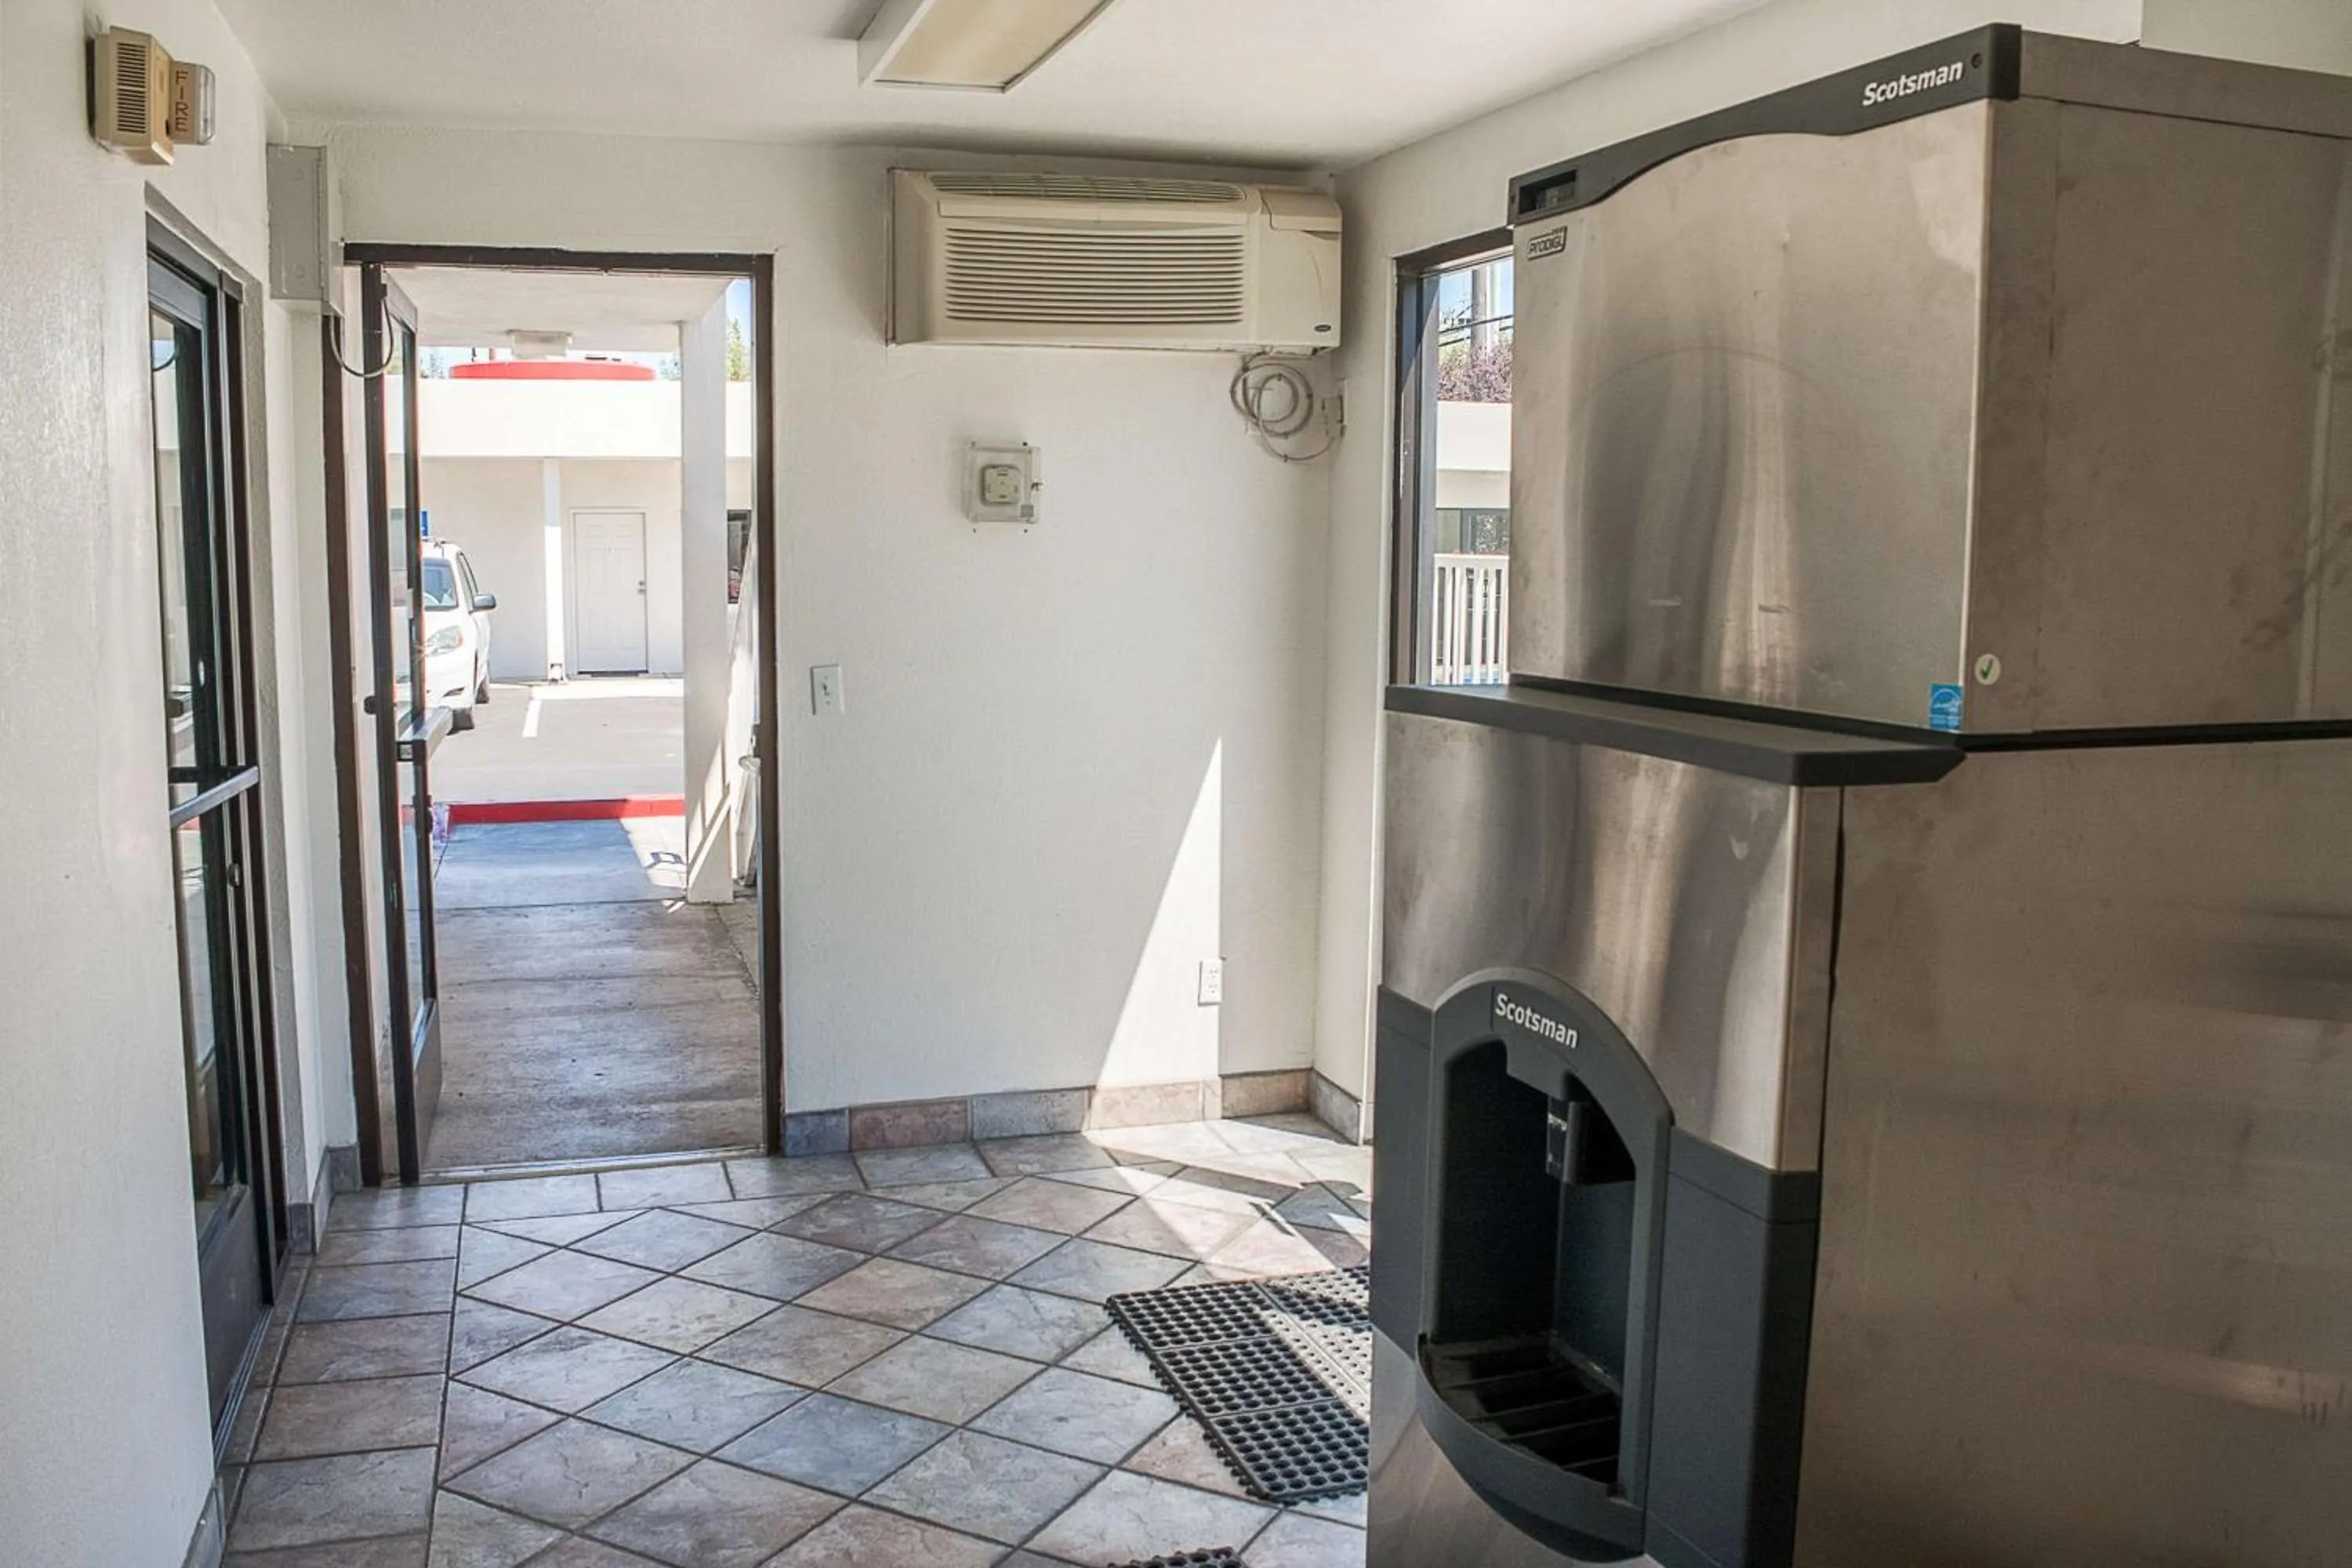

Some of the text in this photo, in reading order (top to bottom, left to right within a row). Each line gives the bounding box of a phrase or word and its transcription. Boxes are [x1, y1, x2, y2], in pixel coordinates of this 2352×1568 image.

[174, 69, 189, 132] FIRE
[1861, 60, 1964, 107] Scotsman
[1494, 992, 1579, 1049] Scotsman
